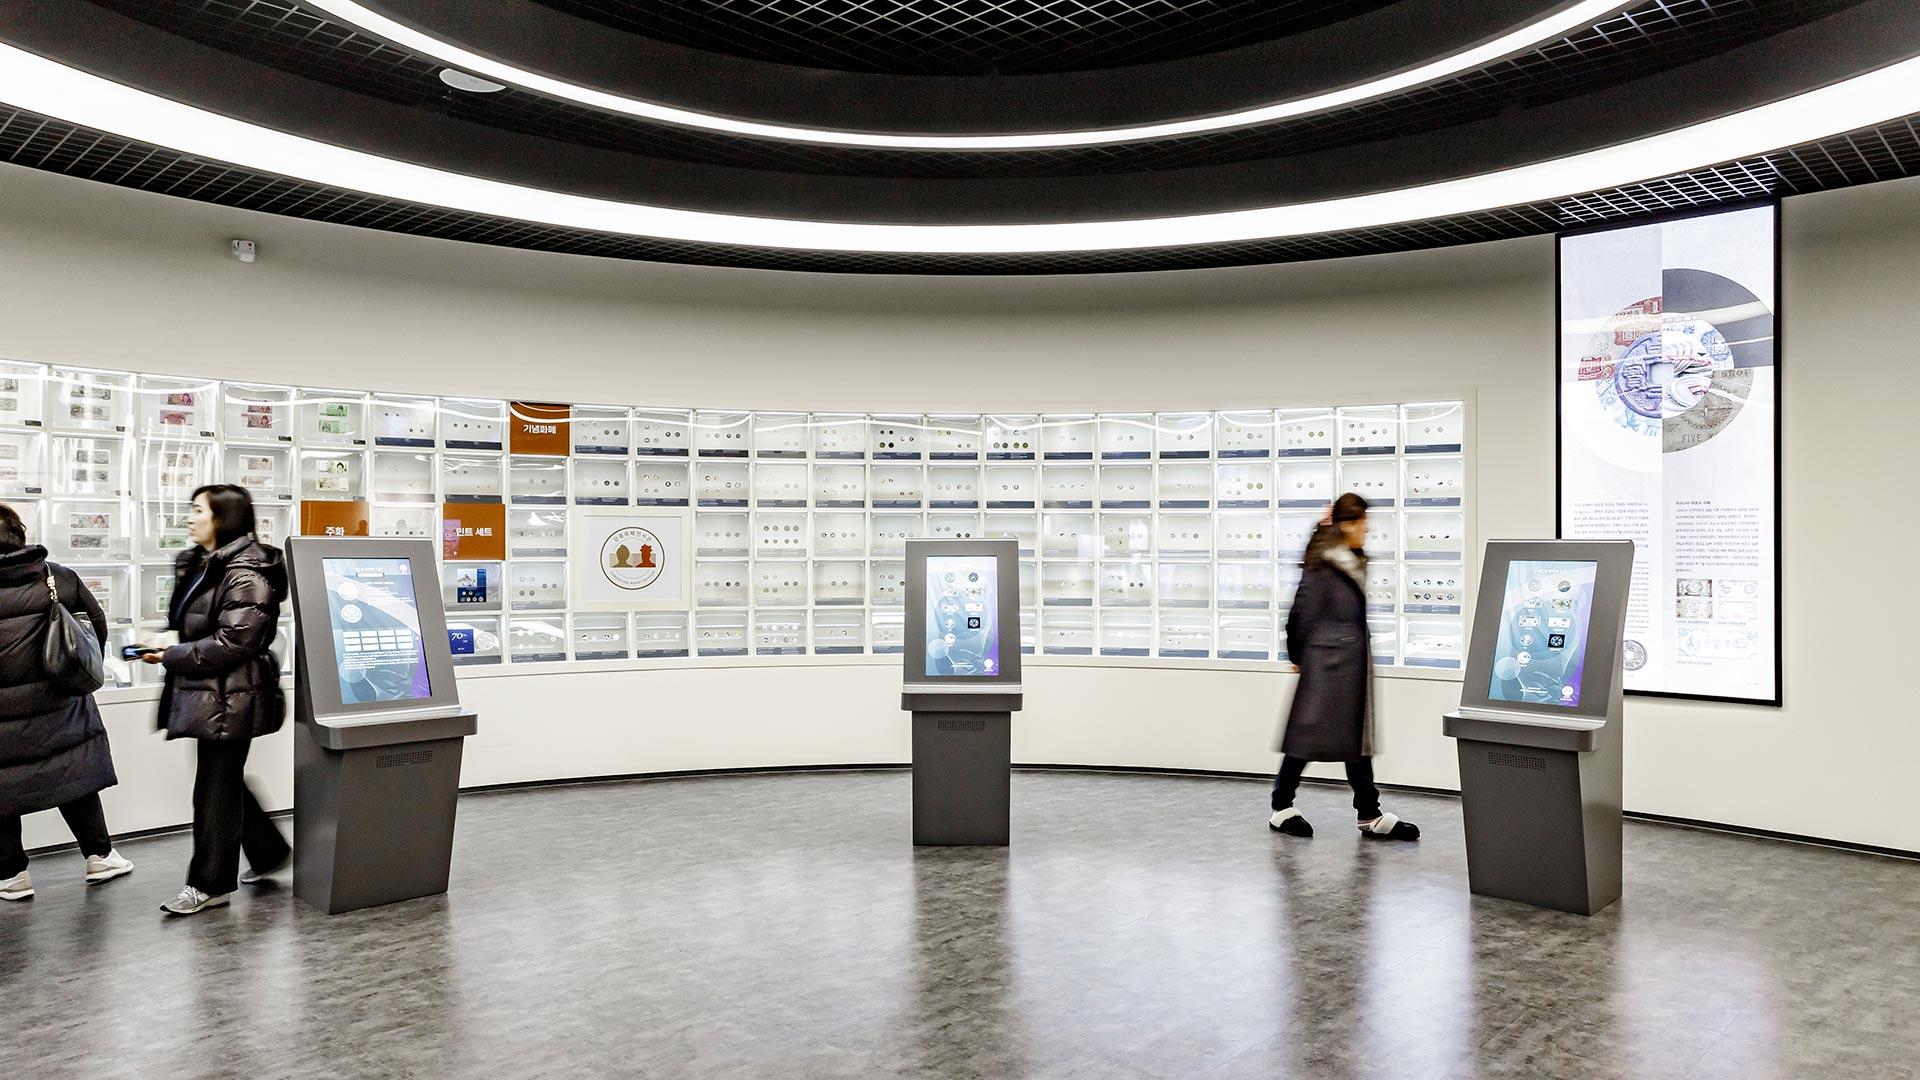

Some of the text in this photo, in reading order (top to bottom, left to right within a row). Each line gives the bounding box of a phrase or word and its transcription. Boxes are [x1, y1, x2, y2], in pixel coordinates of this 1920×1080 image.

[523, 424, 557, 435] 기념화폐
[325, 526, 345, 537] 주화
[456, 527, 493, 537] 민트 세트
